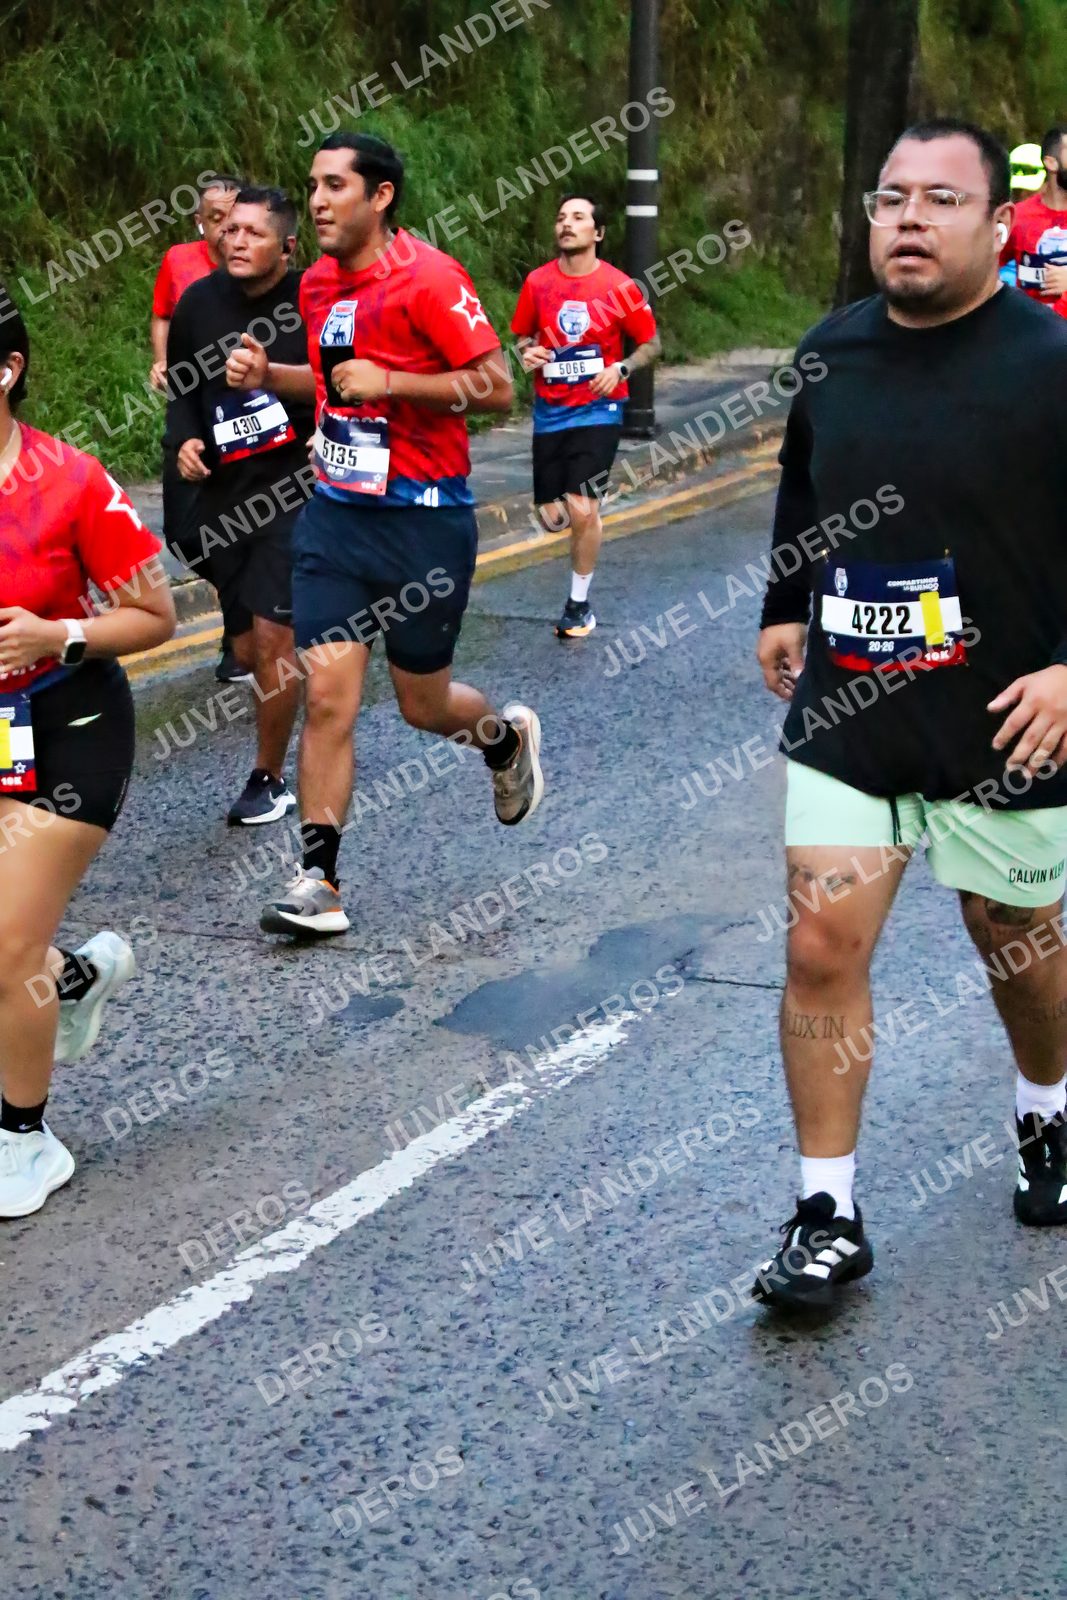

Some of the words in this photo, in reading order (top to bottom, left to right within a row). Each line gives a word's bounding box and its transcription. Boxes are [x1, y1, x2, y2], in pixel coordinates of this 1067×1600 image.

[559, 362, 586, 375] 5066
[232, 416, 262, 437] 4310
[322, 440, 358, 466] 5135
[852, 604, 912, 634] 4222
[925, 650, 950, 661] 10K
[1009, 868, 1047, 884] CALVIN
[823, 1015, 846, 1038] IN
